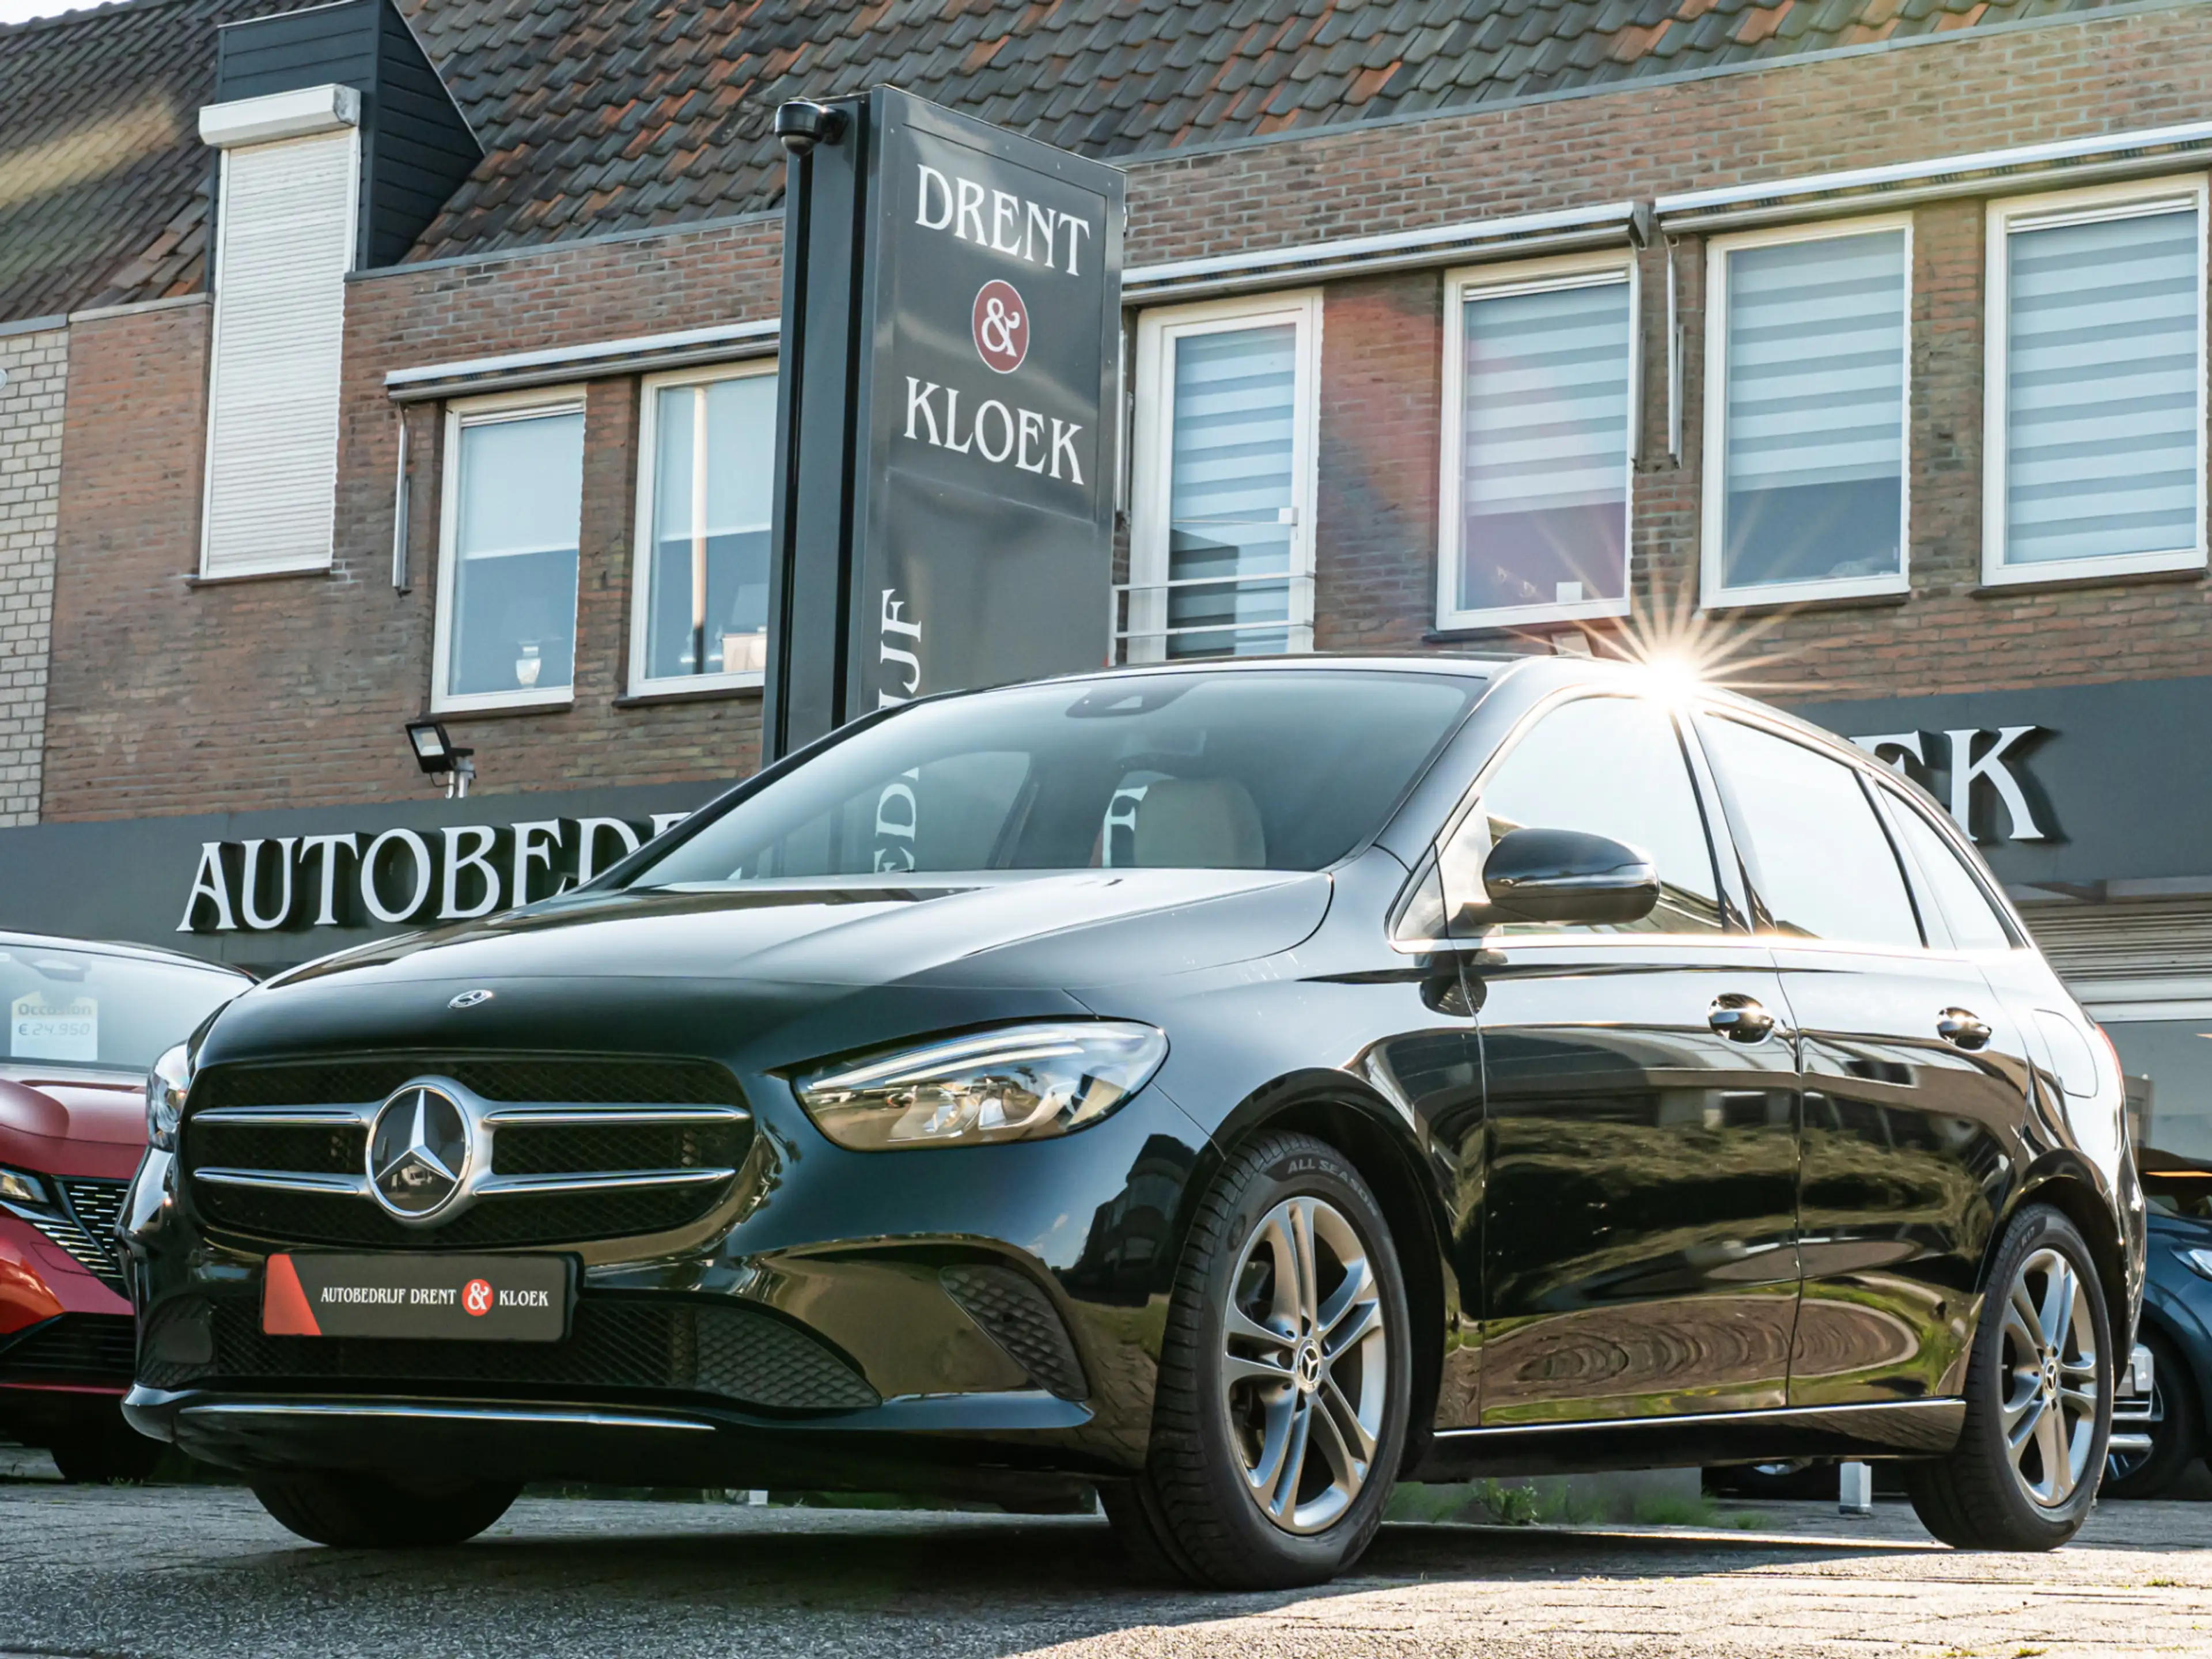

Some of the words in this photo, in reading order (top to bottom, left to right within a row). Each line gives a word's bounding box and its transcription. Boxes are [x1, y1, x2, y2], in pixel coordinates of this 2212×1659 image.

[915, 164, 1090, 276] DRENT
[980, 297, 1020, 358] &
[904, 376, 1085, 486] KLOEK
[175, 812, 693, 933] AUTOBED
[18, 1003, 92, 1016] Occasion
[18, 1022, 29, 1036] €
[32, 1022, 90, 1036] 24.950
[1286, 1158, 1316, 1175] ALL
[320, 1287, 406, 1304] AUTOBEDRIJF
[410, 1289, 457, 1305] DRENT
[467, 1282, 490, 1310] &
[499, 1290, 549, 1306] KLOEK
